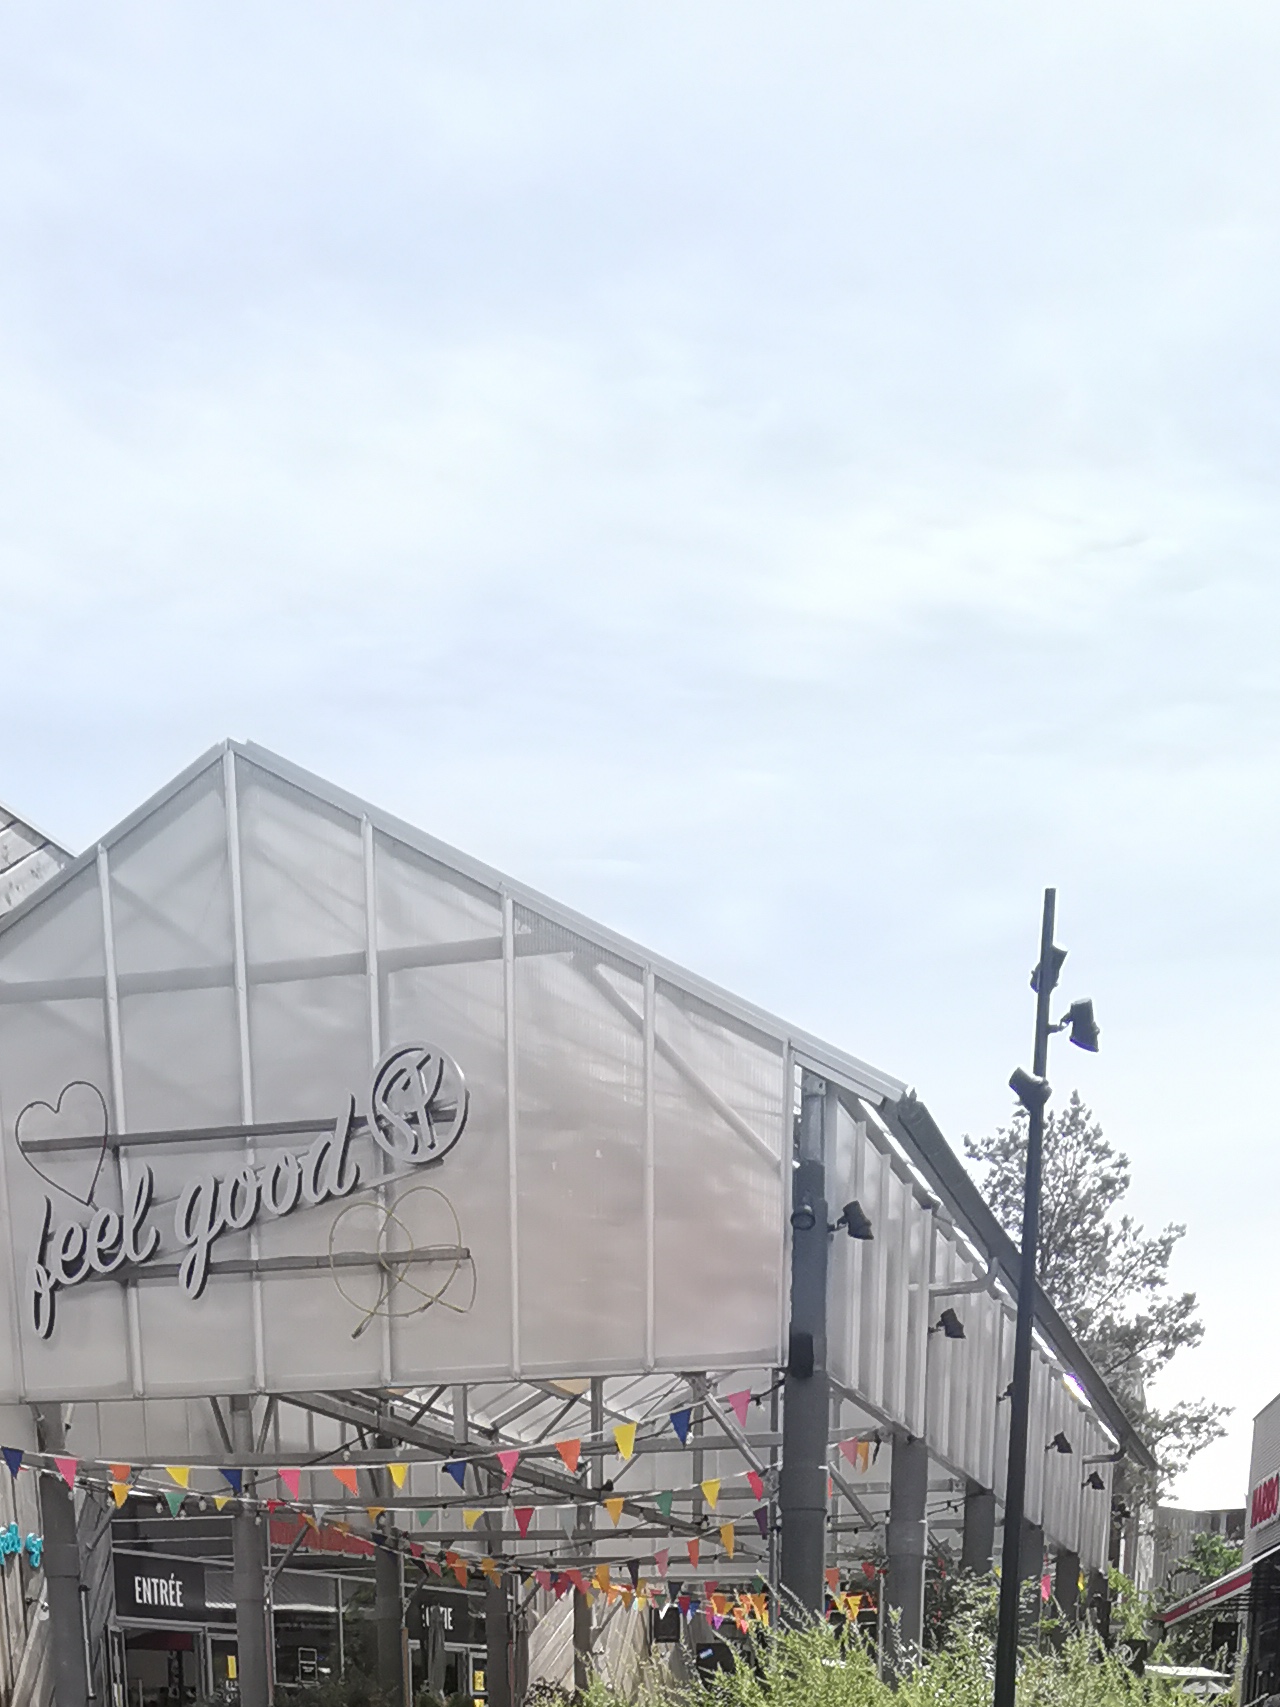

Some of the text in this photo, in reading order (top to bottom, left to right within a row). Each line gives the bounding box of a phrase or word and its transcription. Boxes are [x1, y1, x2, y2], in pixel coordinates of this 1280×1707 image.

[26, 1093, 361, 1340] feel good
[134, 1572, 184, 1607] ENTRÉE
